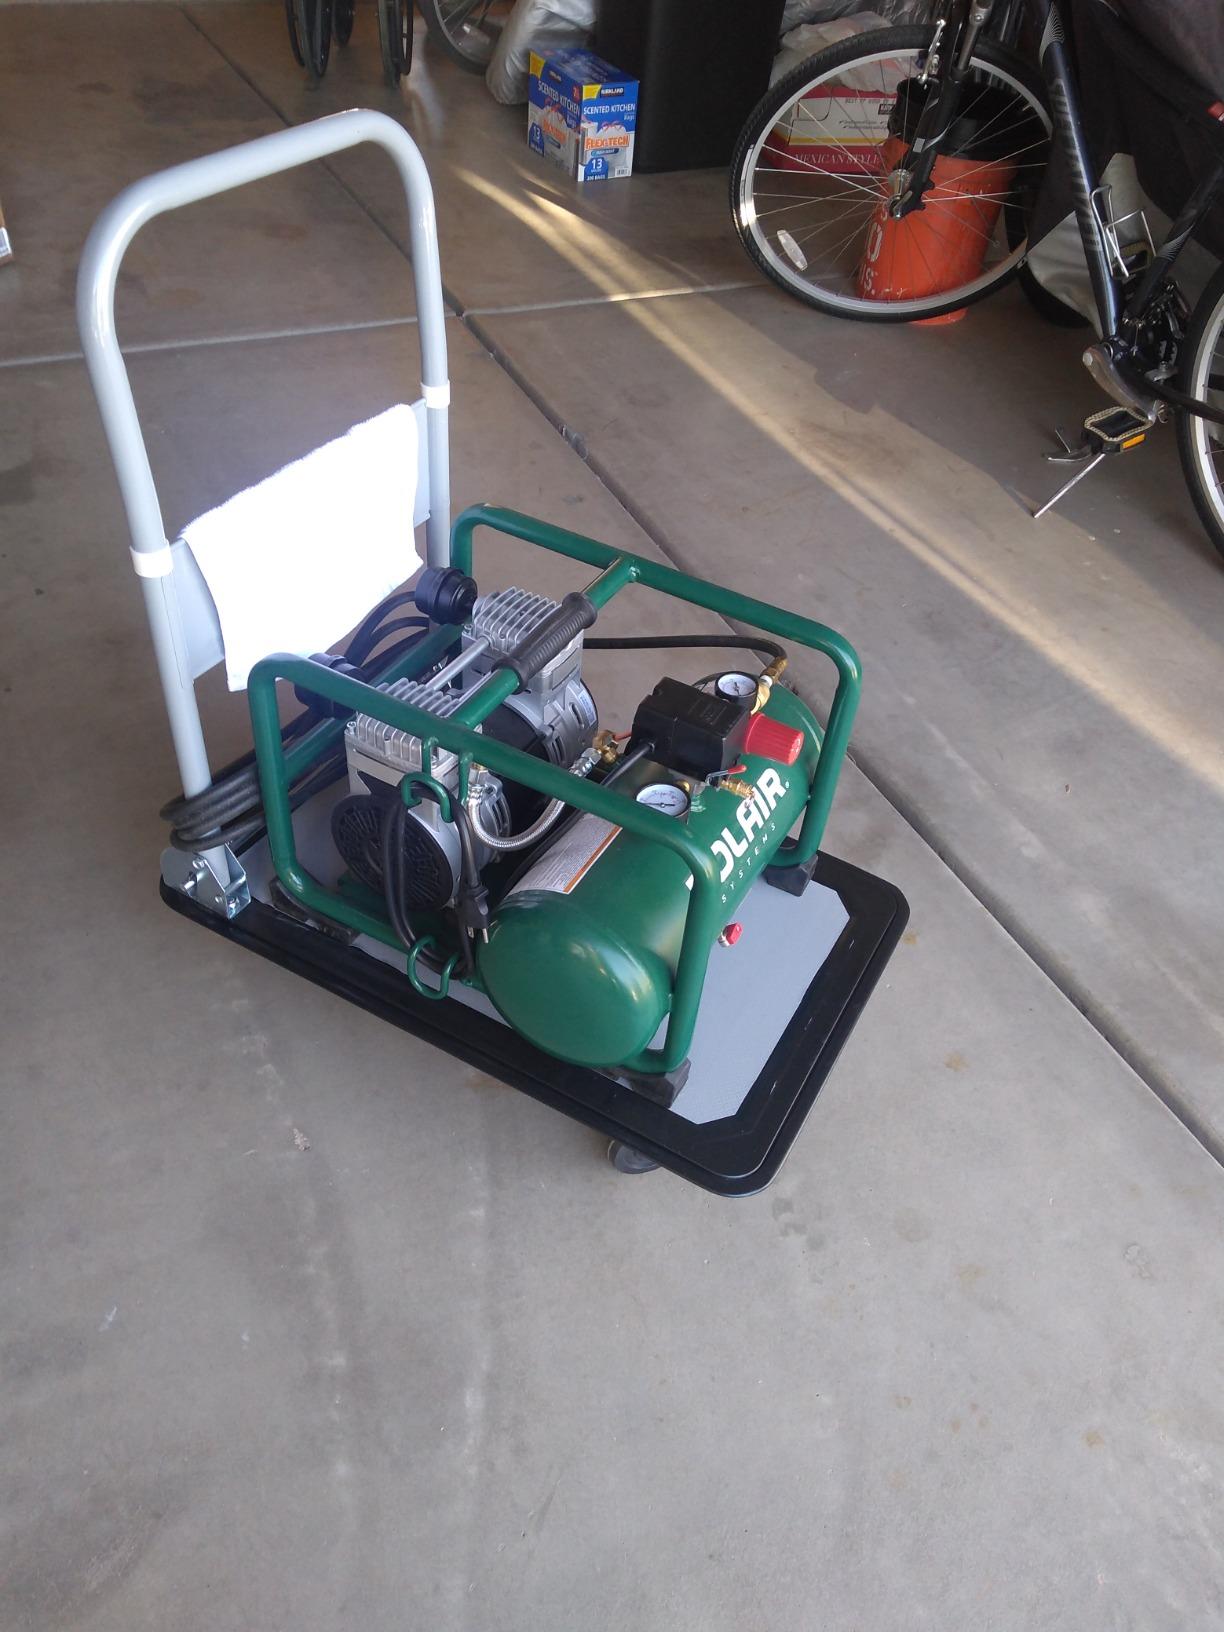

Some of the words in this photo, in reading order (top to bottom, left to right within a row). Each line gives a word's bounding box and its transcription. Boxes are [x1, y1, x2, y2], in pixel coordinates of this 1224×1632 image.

[538, 80, 559, 102] SCENTED
[560, 94, 580, 117] KITCHEN
[583, 105, 610, 115] SCENTED
[610, 103, 636, 113] KITCHEN
[591, 158, 603, 169] 13
[795, 153, 844, 164] MEXICAN
[846, 153, 880, 165] STYLE
[685, 767, 787, 891] OLAIR
